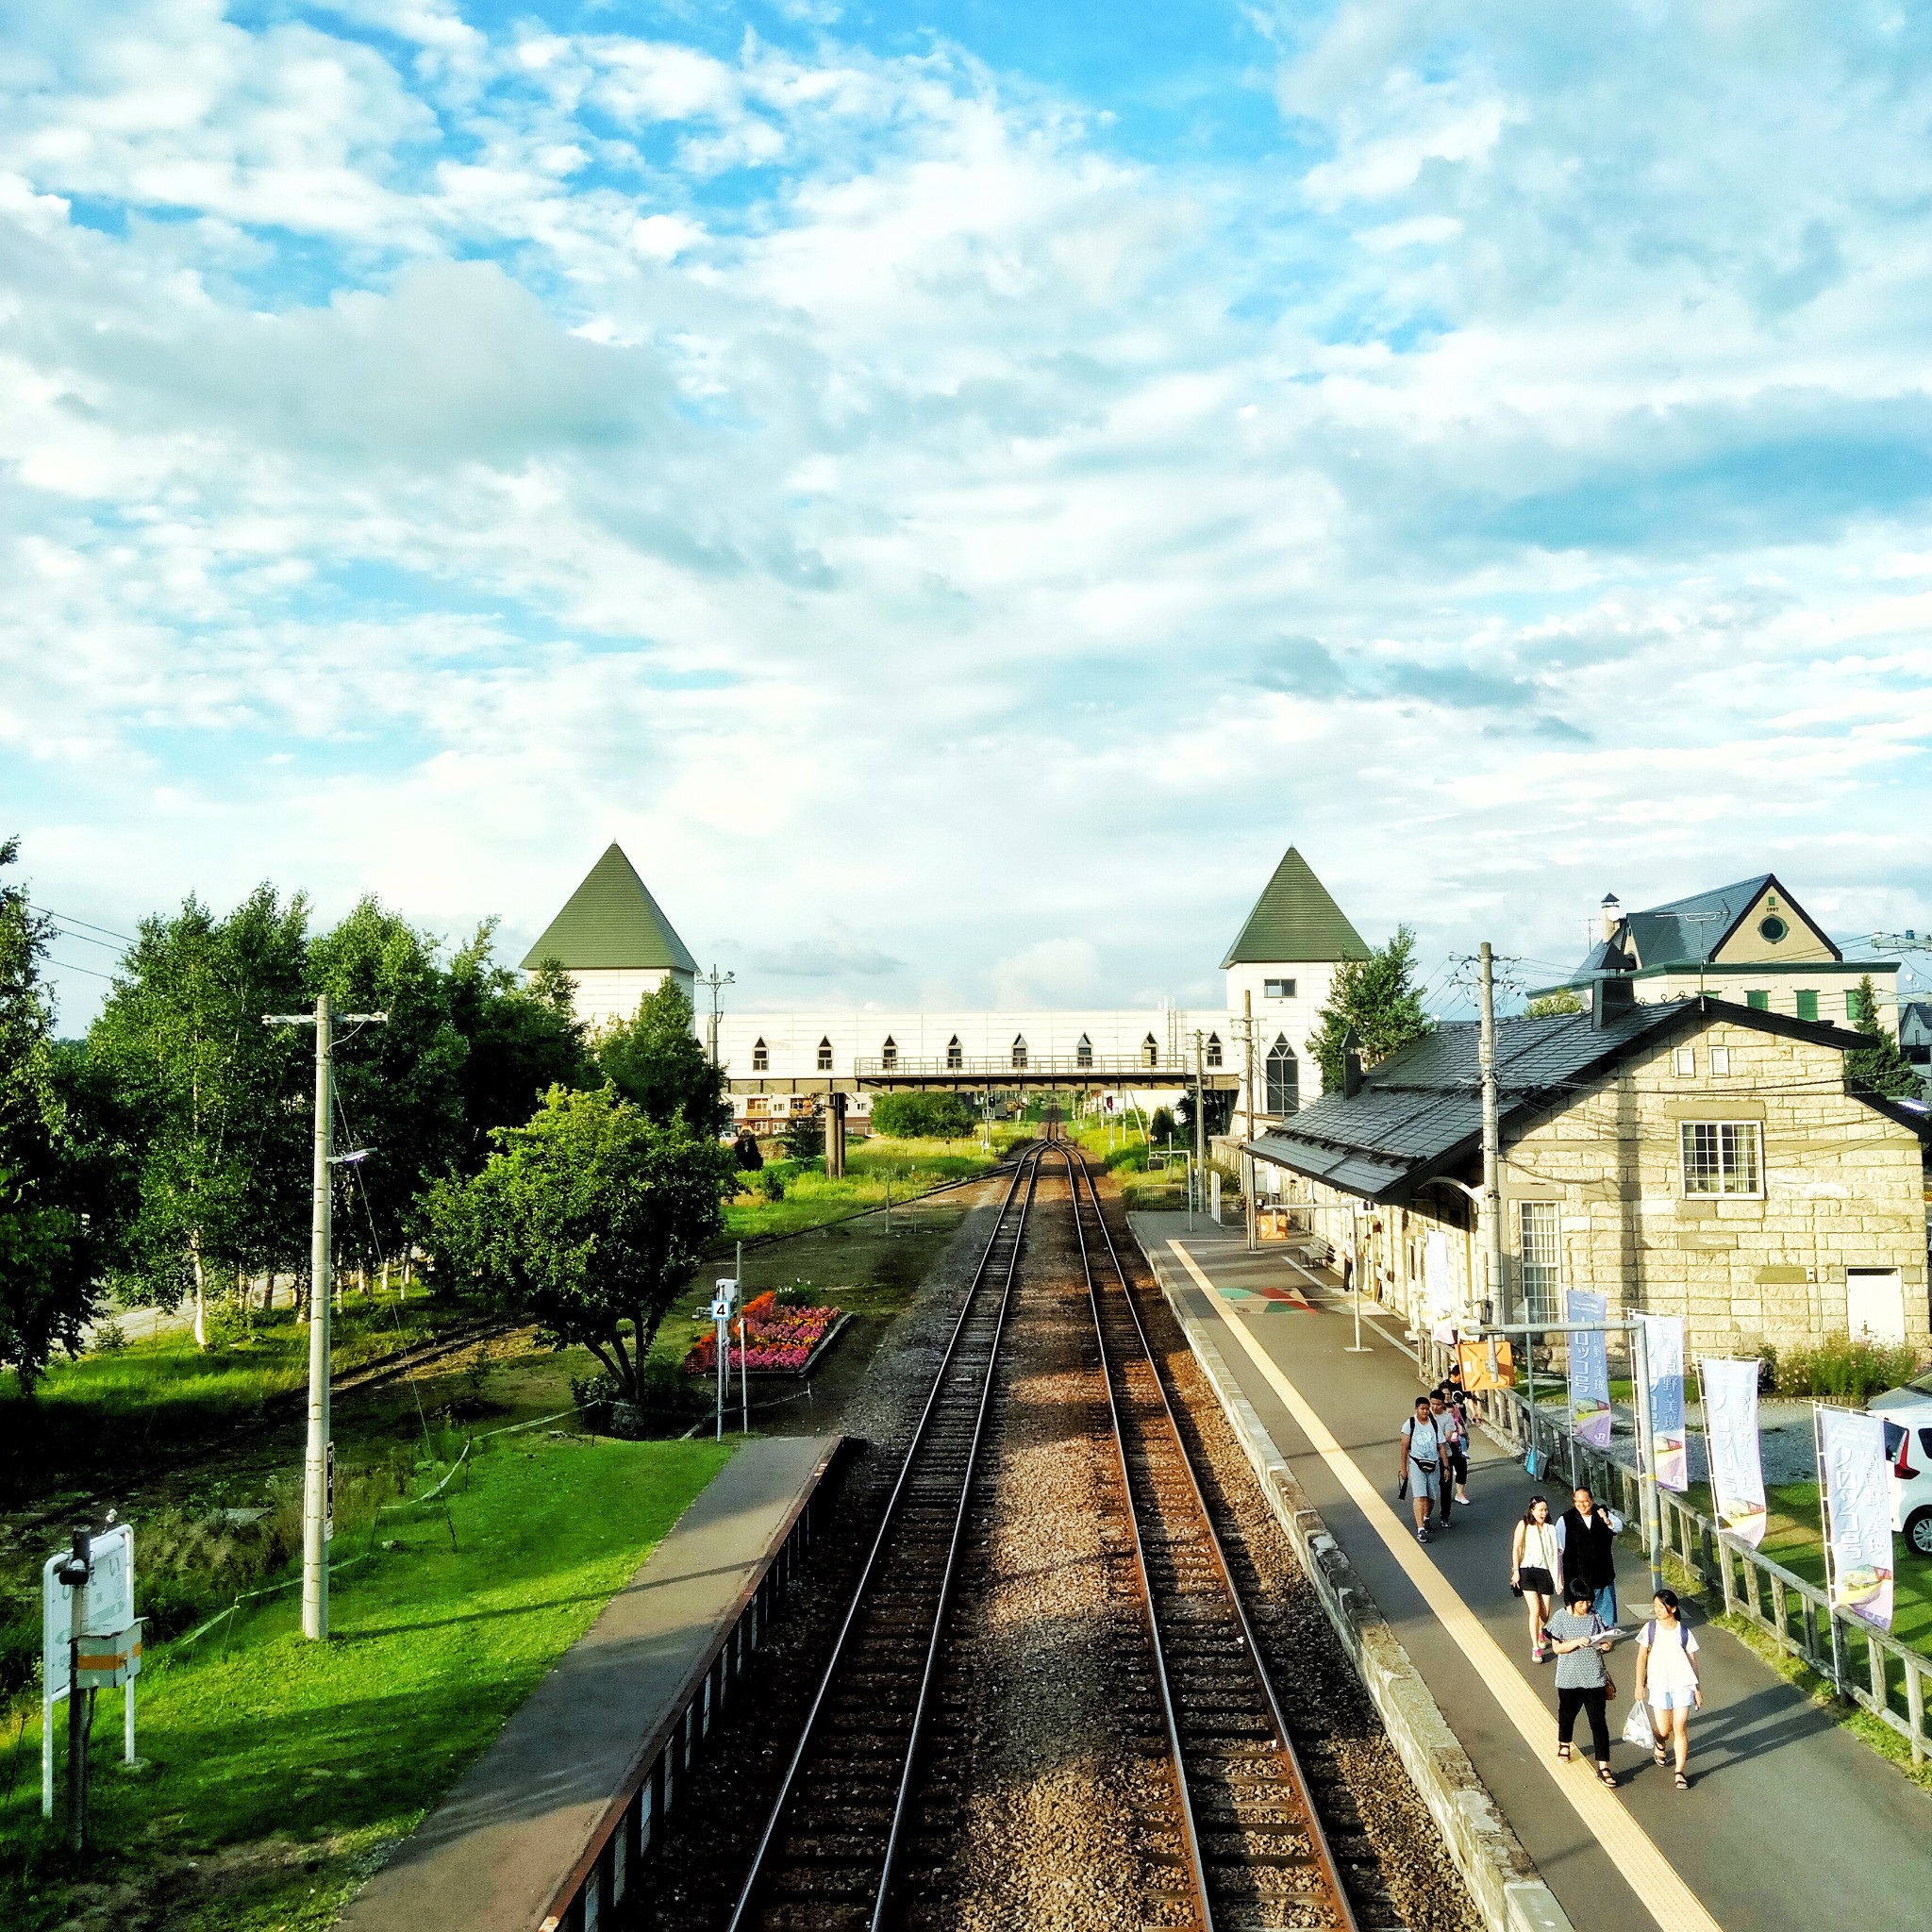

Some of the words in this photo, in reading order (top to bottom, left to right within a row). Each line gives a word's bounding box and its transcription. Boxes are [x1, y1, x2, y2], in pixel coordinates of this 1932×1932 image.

[716, 1304, 726, 1315] 4
[1591, 1318, 1607, 1393] 良野・美瑛
[1594, 1432, 1606, 1441] JR
[1667, 1475, 1683, 1486] JR
[1834, 1444, 1863, 1559] ノロッコ号
